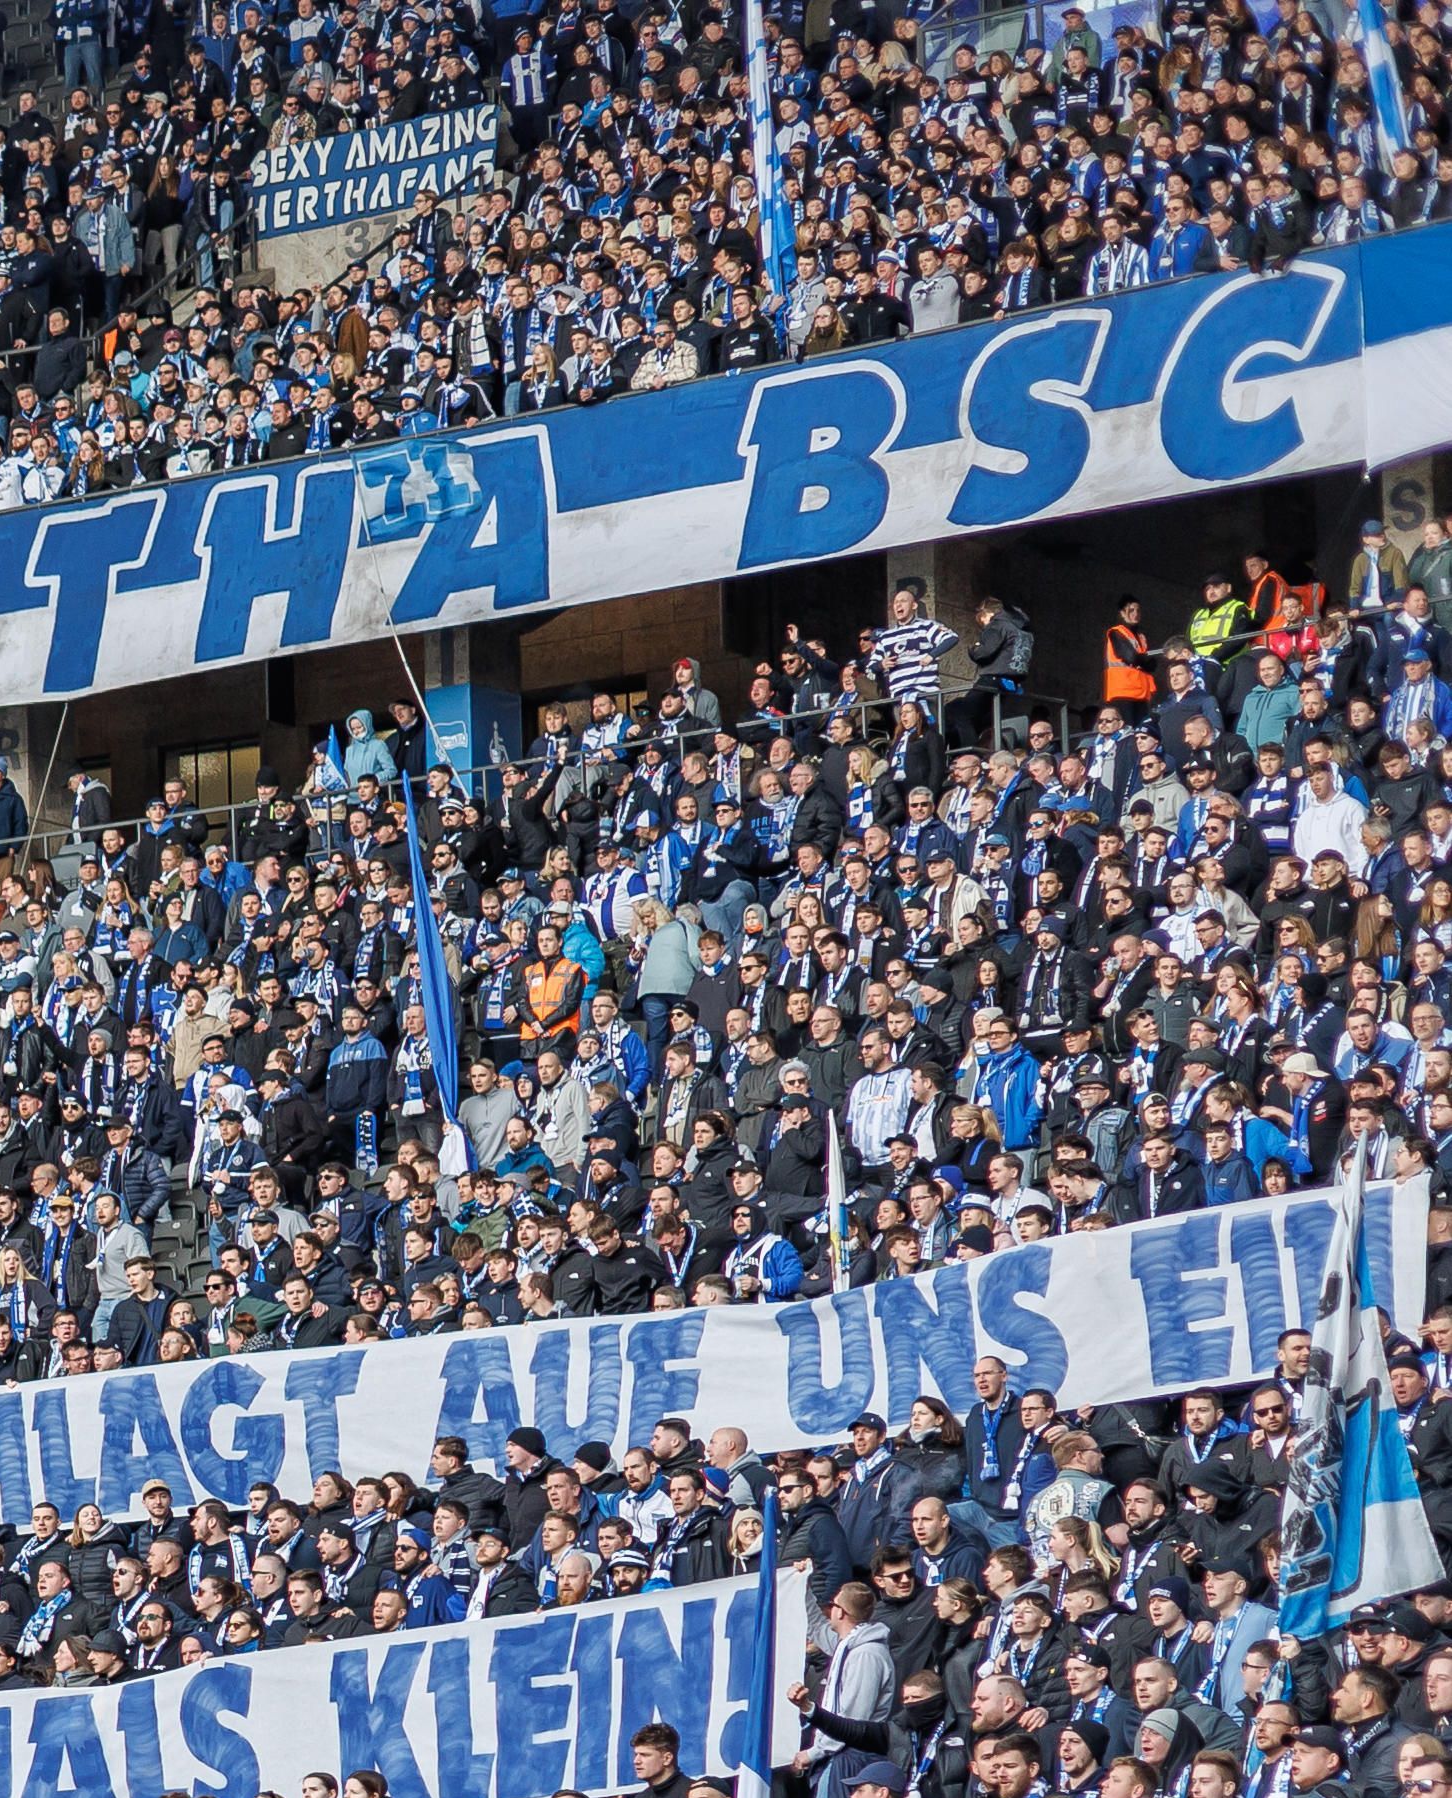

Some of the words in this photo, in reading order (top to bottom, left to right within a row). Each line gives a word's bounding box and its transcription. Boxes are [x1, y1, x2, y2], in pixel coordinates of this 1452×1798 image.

[250, 137, 334, 189] SEXY
[345, 105, 498, 171] AMAZING
[247, 149, 496, 232] HERTHAFANS
[735, 259, 1348, 571] BSC
[1389, 478, 1427, 531] S
[424, 1308, 708, 1487] AUF
[774, 1243, 1073, 1437] UNS
